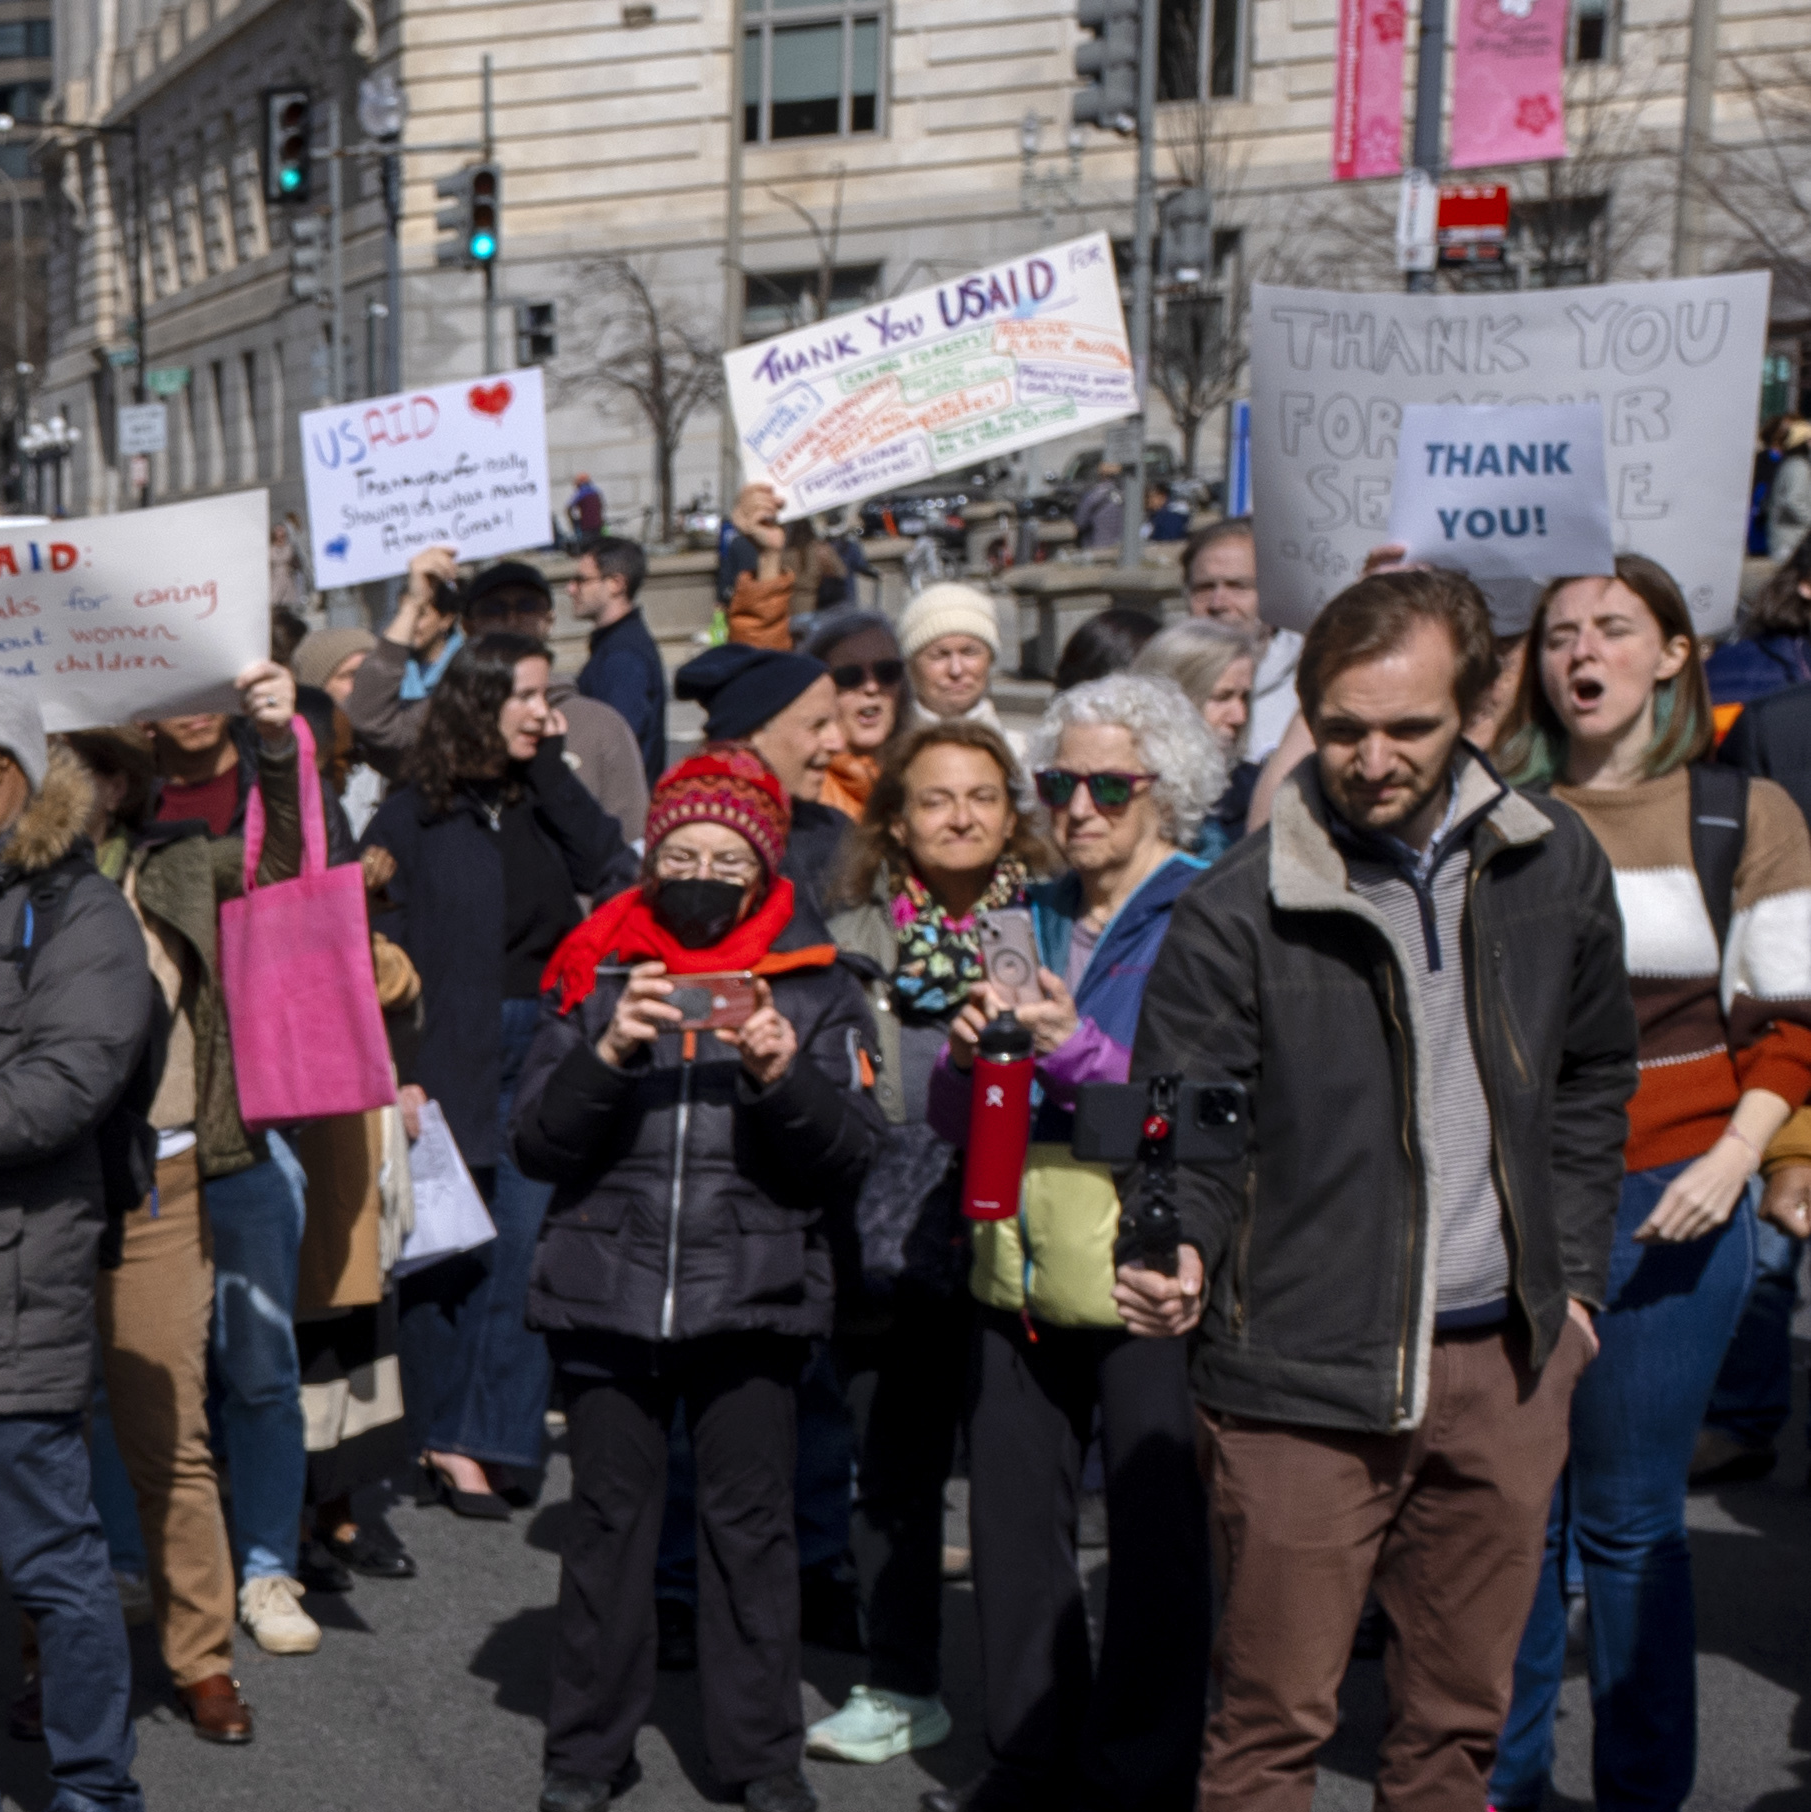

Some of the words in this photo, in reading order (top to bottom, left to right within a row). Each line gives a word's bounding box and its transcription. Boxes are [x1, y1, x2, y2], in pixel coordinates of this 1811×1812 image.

[753, 332, 862, 386] THANK
[937, 258, 1057, 329] USAID
[1270, 304, 1531, 376] THANK
[1565, 298, 1730, 375] YOU
[312, 394, 440, 470] USAID
[1280, 390, 1399, 461] FOR
[1424, 442, 1574, 478] THANK
[1436, 507, 1547, 542] YOU!
[65, 586, 111, 611] for
[133, 578, 219, 621] caring
[69, 624, 182, 643] women
[55, 651, 177, 674] children
